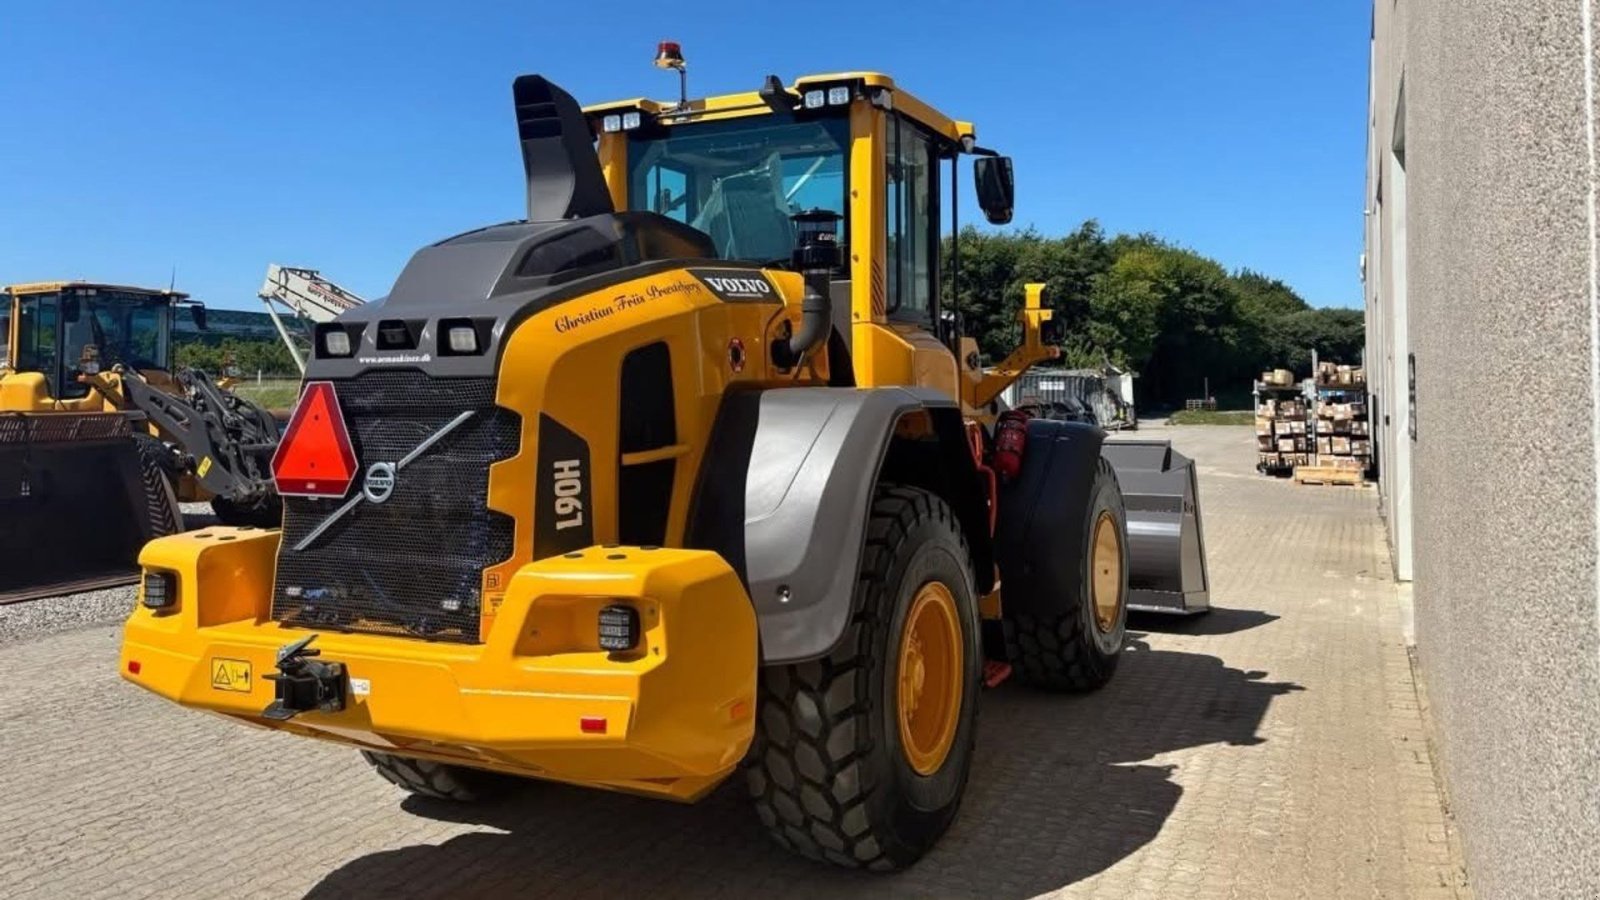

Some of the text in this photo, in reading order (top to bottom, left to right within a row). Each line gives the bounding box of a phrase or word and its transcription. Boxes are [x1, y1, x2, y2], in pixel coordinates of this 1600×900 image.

[703, 277, 770, 293] VOLVO
[555, 306, 614, 333] Christian
[614, 295, 646, 311] Friis
[365, 479, 392, 487] VOLVO
[553, 459, 583, 531] L90H
